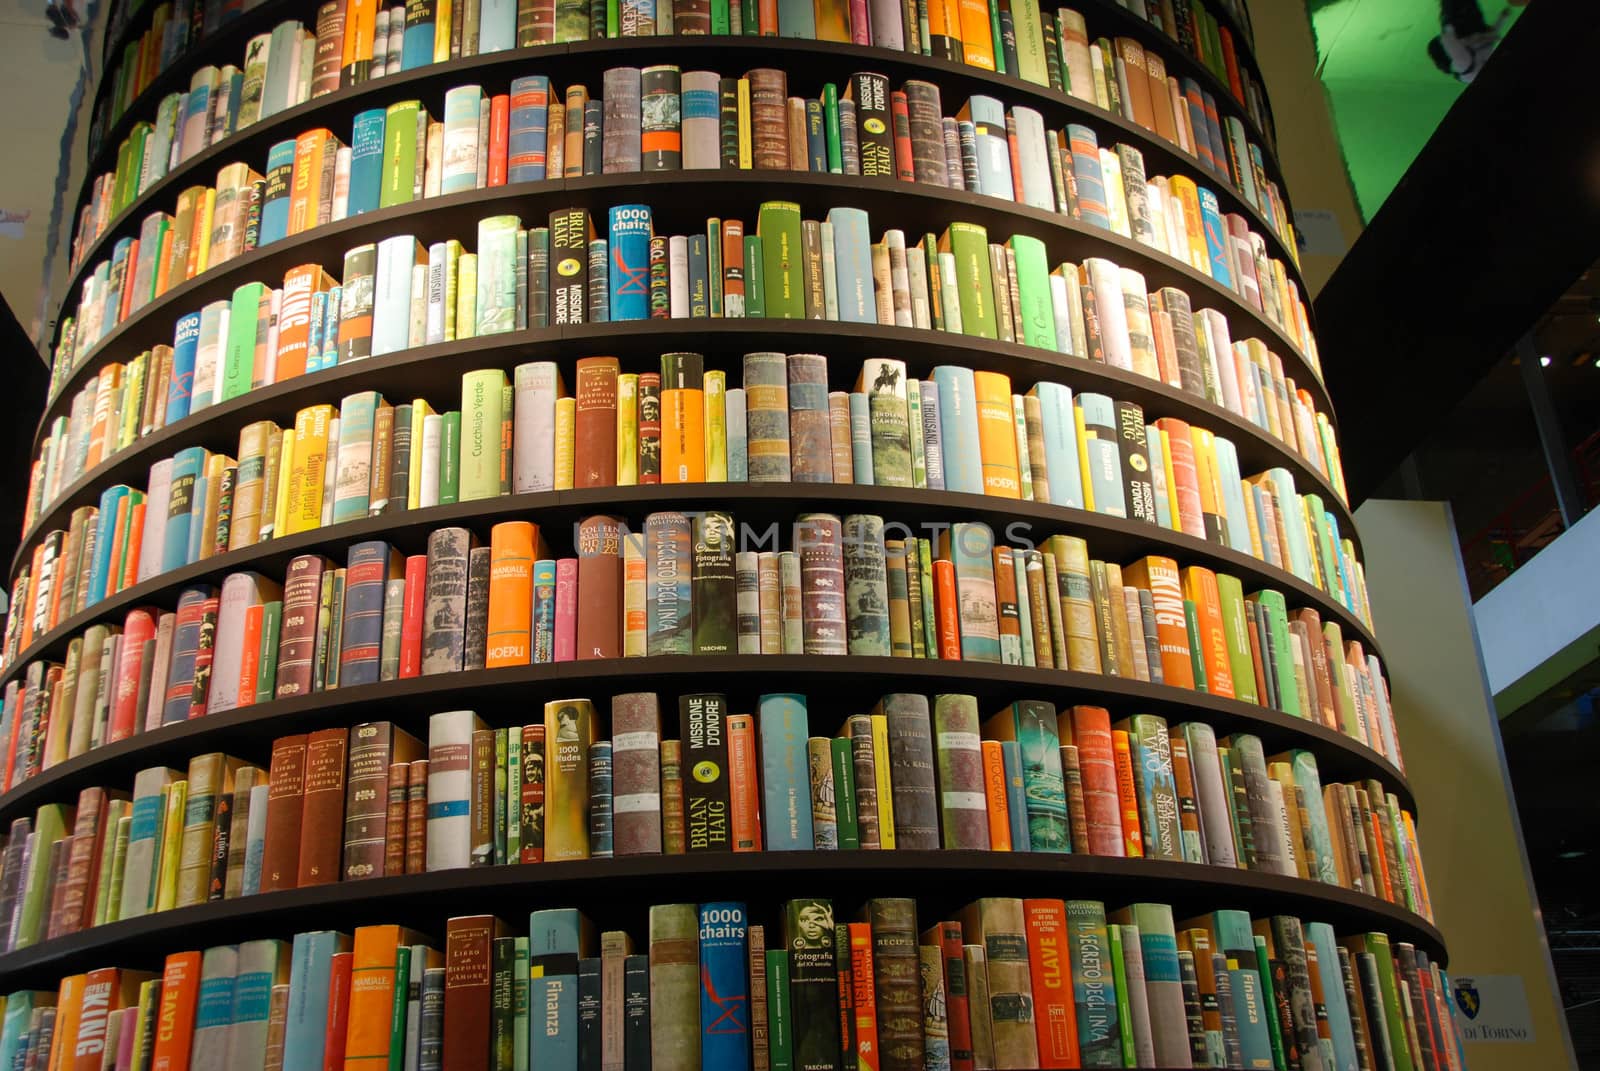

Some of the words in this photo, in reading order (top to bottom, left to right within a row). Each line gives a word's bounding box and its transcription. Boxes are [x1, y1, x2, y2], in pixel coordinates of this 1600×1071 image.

[862, 75, 872, 110] MISSIONE
[875, 79, 886, 111] D'ONORE
[297, 149, 311, 191] CLAVE
[863, 141, 878, 176] BRIAN
[878, 146, 891, 176] HAIG
[554, 216, 568, 248] HAIG
[569, 211, 584, 249] BRIAN
[612, 219, 650, 232] chairs
[615, 208, 649, 220] 1000
[430, 263, 442, 304] THOUSAND
[556, 287, 567, 325] D'ONORE
[570, 285, 582, 324] MISSIONE
[472, 381, 485, 410] Verde
[927, 402, 939, 446] THOUSAND
[1121, 407, 1135, 441] HAIG
[1133, 407, 1146, 447] BRIAN
[1130, 480, 1146, 518] D'ONORE
[1142, 481, 1155, 524] MISSIONE
[695, 555, 732, 564] Fotografia
[656, 580, 680, 606] DEGLI
[1150, 576, 1187, 628] KING
[656, 607, 680, 632] INCA
[488, 646, 524, 660] HOEPLI
[1211, 628, 1225, 669] CLAVE
[689, 698, 703, 749] MISSIONE
[706, 700, 721, 746] D'ONORE
[558, 746, 578, 754] 1000
[1116, 752, 1132, 804] English
[691, 797, 708, 849] BRIAN
[708, 801, 725, 843] HAIG
[272, 872, 280, 881] S
[311, 866, 319, 875] S
[700, 924, 745, 941] chairs
[702, 909, 742, 925] 1000
[454, 950, 480, 958] LIBRO
[794, 952, 833, 962] Fotografia
[877, 938, 914, 946] RECIPES
[1079, 931, 1101, 979] SEGRETO
[852, 950, 866, 1009] English
[864, 949, 873, 1007] MACMILLAN
[1041, 937, 1062, 989] CLAVE
[494, 988, 503, 1008] LUPI
[502, 970, 511, 1009] L'IMPERO
[1085, 980, 1105, 1011] DEGLI
[1244, 974, 1259, 1025] Finanza
[76, 990, 112, 1056] KING
[160, 991, 179, 1042] CLAVE
[546, 980, 565, 1037] Finanza
[1088, 1013, 1109, 1042] INCA
[1464, 1028, 1476, 1040] DI
[1479, 1025, 1527, 1040] TORINO
